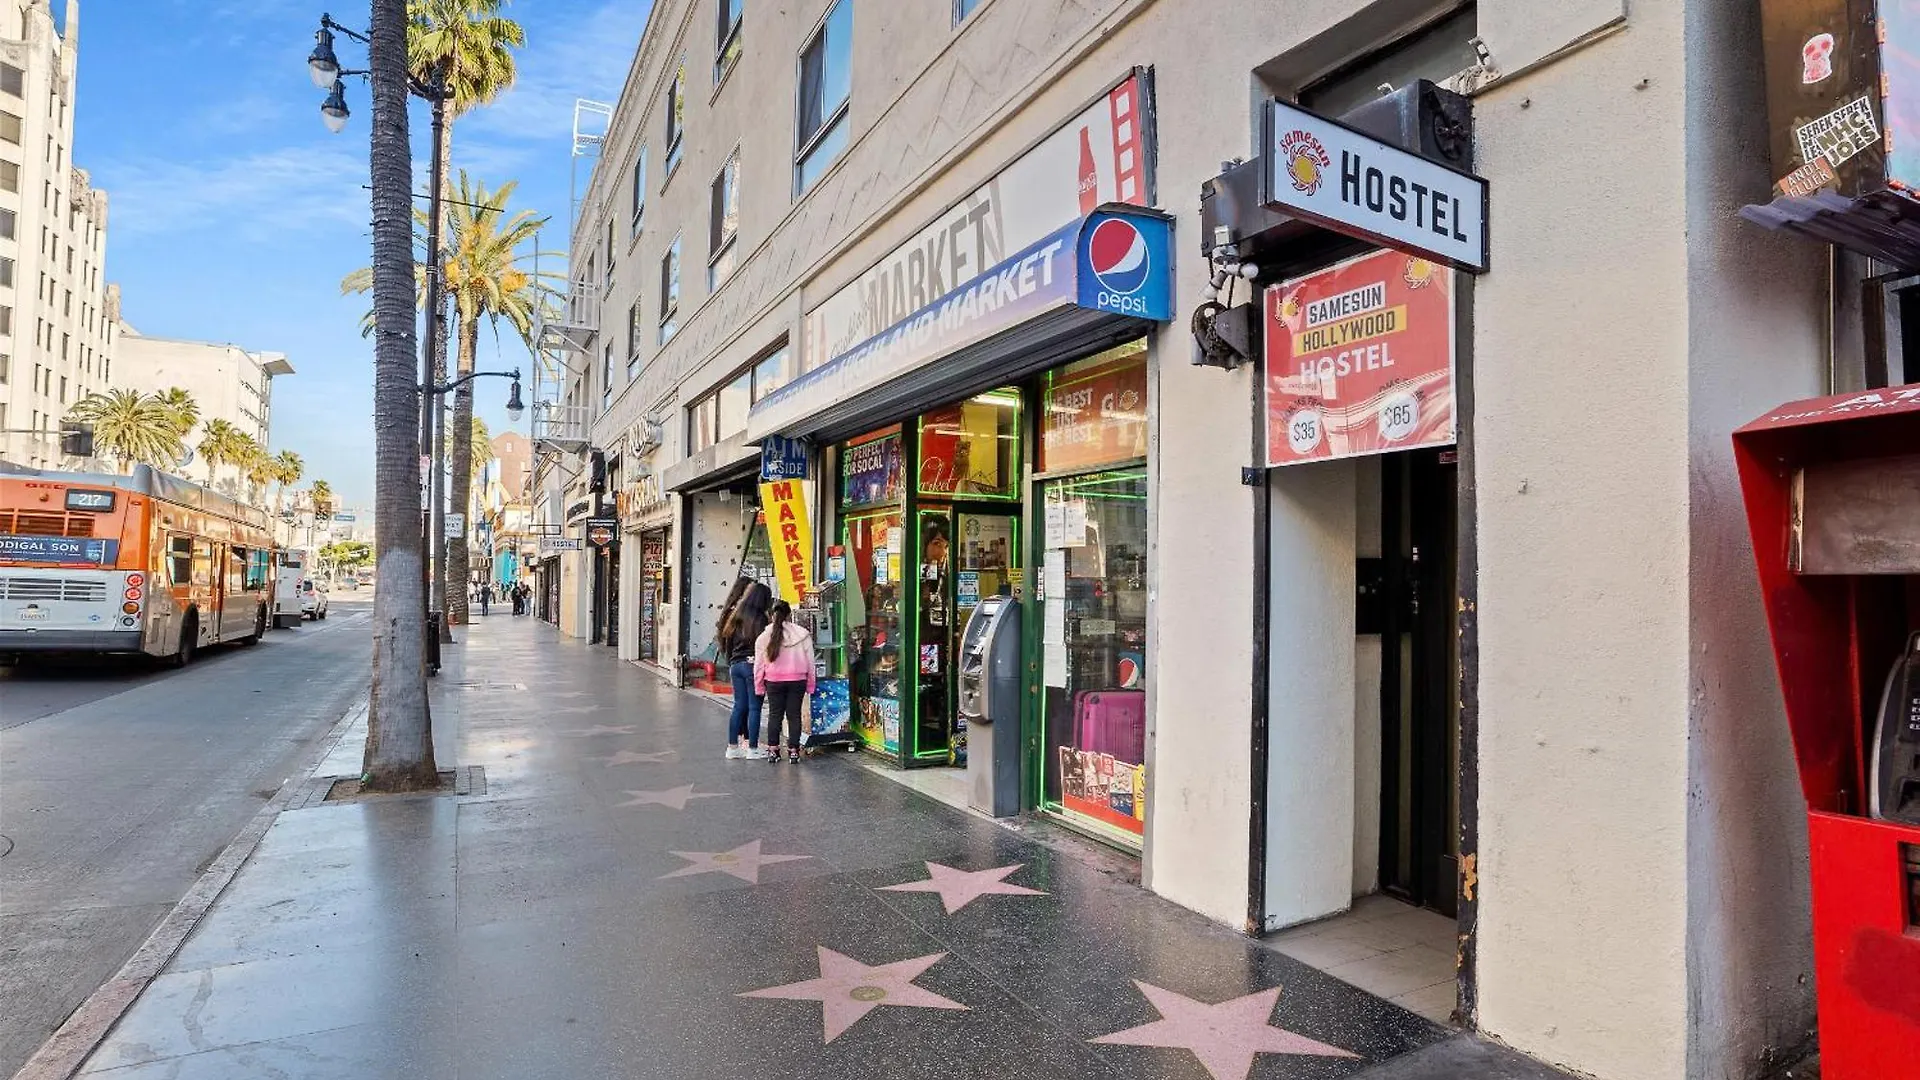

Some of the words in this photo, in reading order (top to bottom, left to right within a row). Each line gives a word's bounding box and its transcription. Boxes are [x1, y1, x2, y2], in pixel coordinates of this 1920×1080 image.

[1341, 150, 1468, 243] HOSTEL
[866, 200, 990, 337] MARKET
[936, 239, 1064, 338] MARKET
[1097, 291, 1147, 314] pepsi
[1309, 284, 1382, 324] SAMESUN
[1302, 310, 1396, 353] HOLLYWOOD
[1301, 342, 1395, 382] HOSTEL
[1293, 420, 1316, 442] $35
[1385, 403, 1411, 429] $65
[79, 493, 102, 506] 217
[51, 543, 80, 552] SON
[772, 481, 807, 602] MARKET
